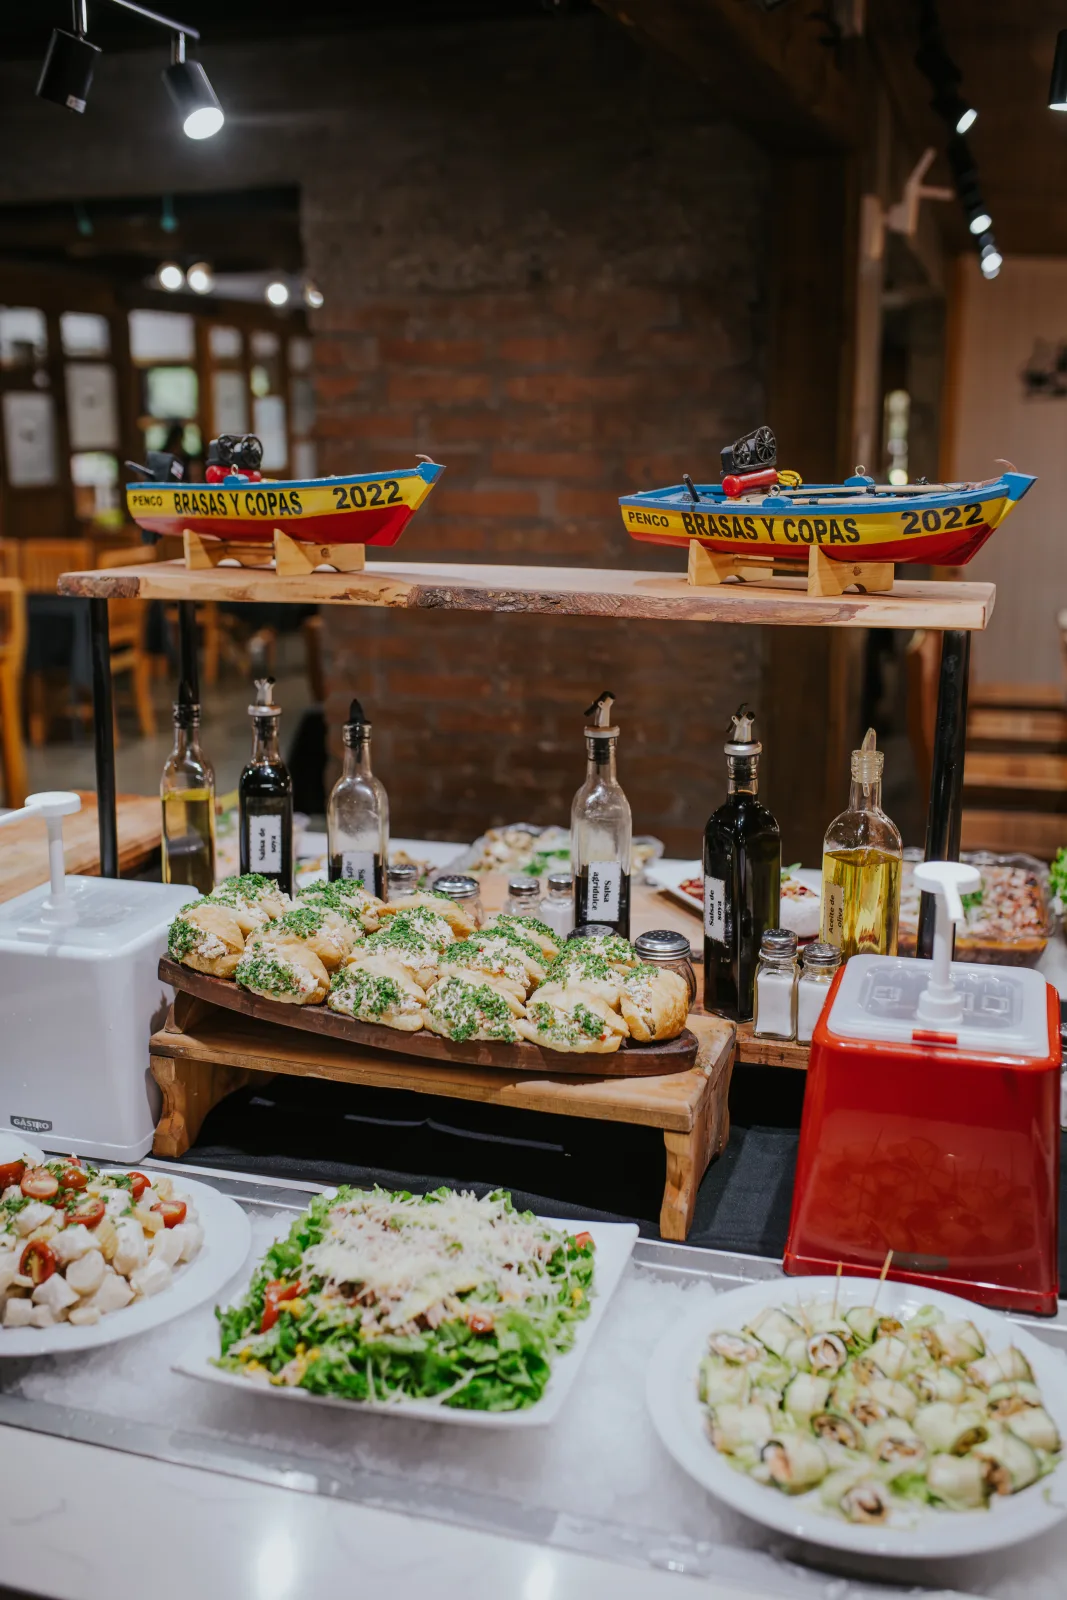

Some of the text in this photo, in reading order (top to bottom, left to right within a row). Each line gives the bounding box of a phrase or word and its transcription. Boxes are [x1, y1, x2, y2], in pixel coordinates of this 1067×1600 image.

[132, 491, 303, 516] PENCO BRASAS Y COPAS
[332, 480, 403, 510] 2022
[627, 511, 861, 544] PENCO BRASAS Y COPAS
[900, 503, 984, 535] 2022
[258, 827, 266, 861] Salsa de
[591, 871, 601, 911] agridulce
[603, 880, 612, 903] Salsa
[709, 889, 715, 901] de
[828, 894, 836, 934] Aceite de
[836, 907, 844, 928] oliva
[13, 1117, 50, 1130] GASTRO
